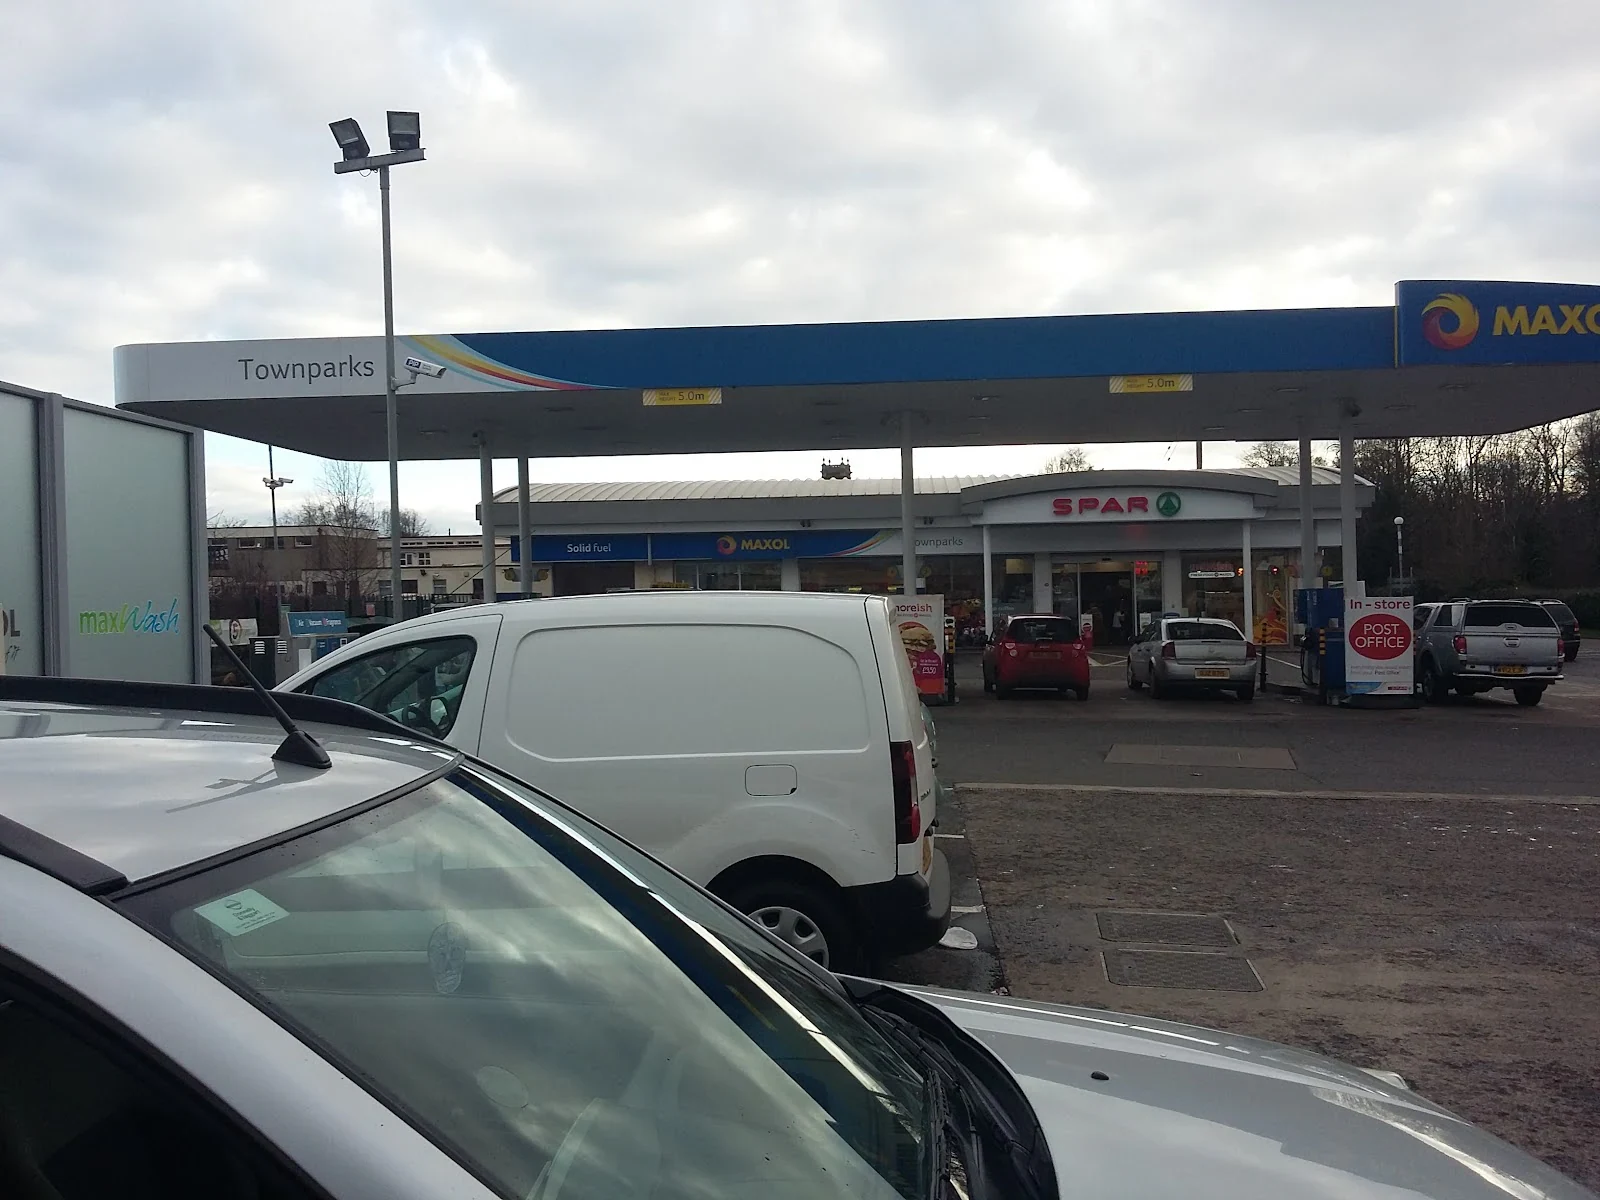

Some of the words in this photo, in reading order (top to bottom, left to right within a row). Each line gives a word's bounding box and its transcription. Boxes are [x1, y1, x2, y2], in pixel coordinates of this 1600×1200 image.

[238, 355, 375, 385] Townparks
[1147, 378, 1175, 389] 5.0m
[678, 390, 705, 401] 5.0m
[1052, 496, 1149, 516] SPAR
[566, 543, 592, 553] Solid
[593, 542, 612, 553] fuel
[741, 538, 791, 550] MAXOL
[914, 536, 964, 548] ownparks
[79, 598, 181, 636] maxWash
[1363, 623, 1400, 635] POST
[1354, 636, 1405, 648] OFFICE
